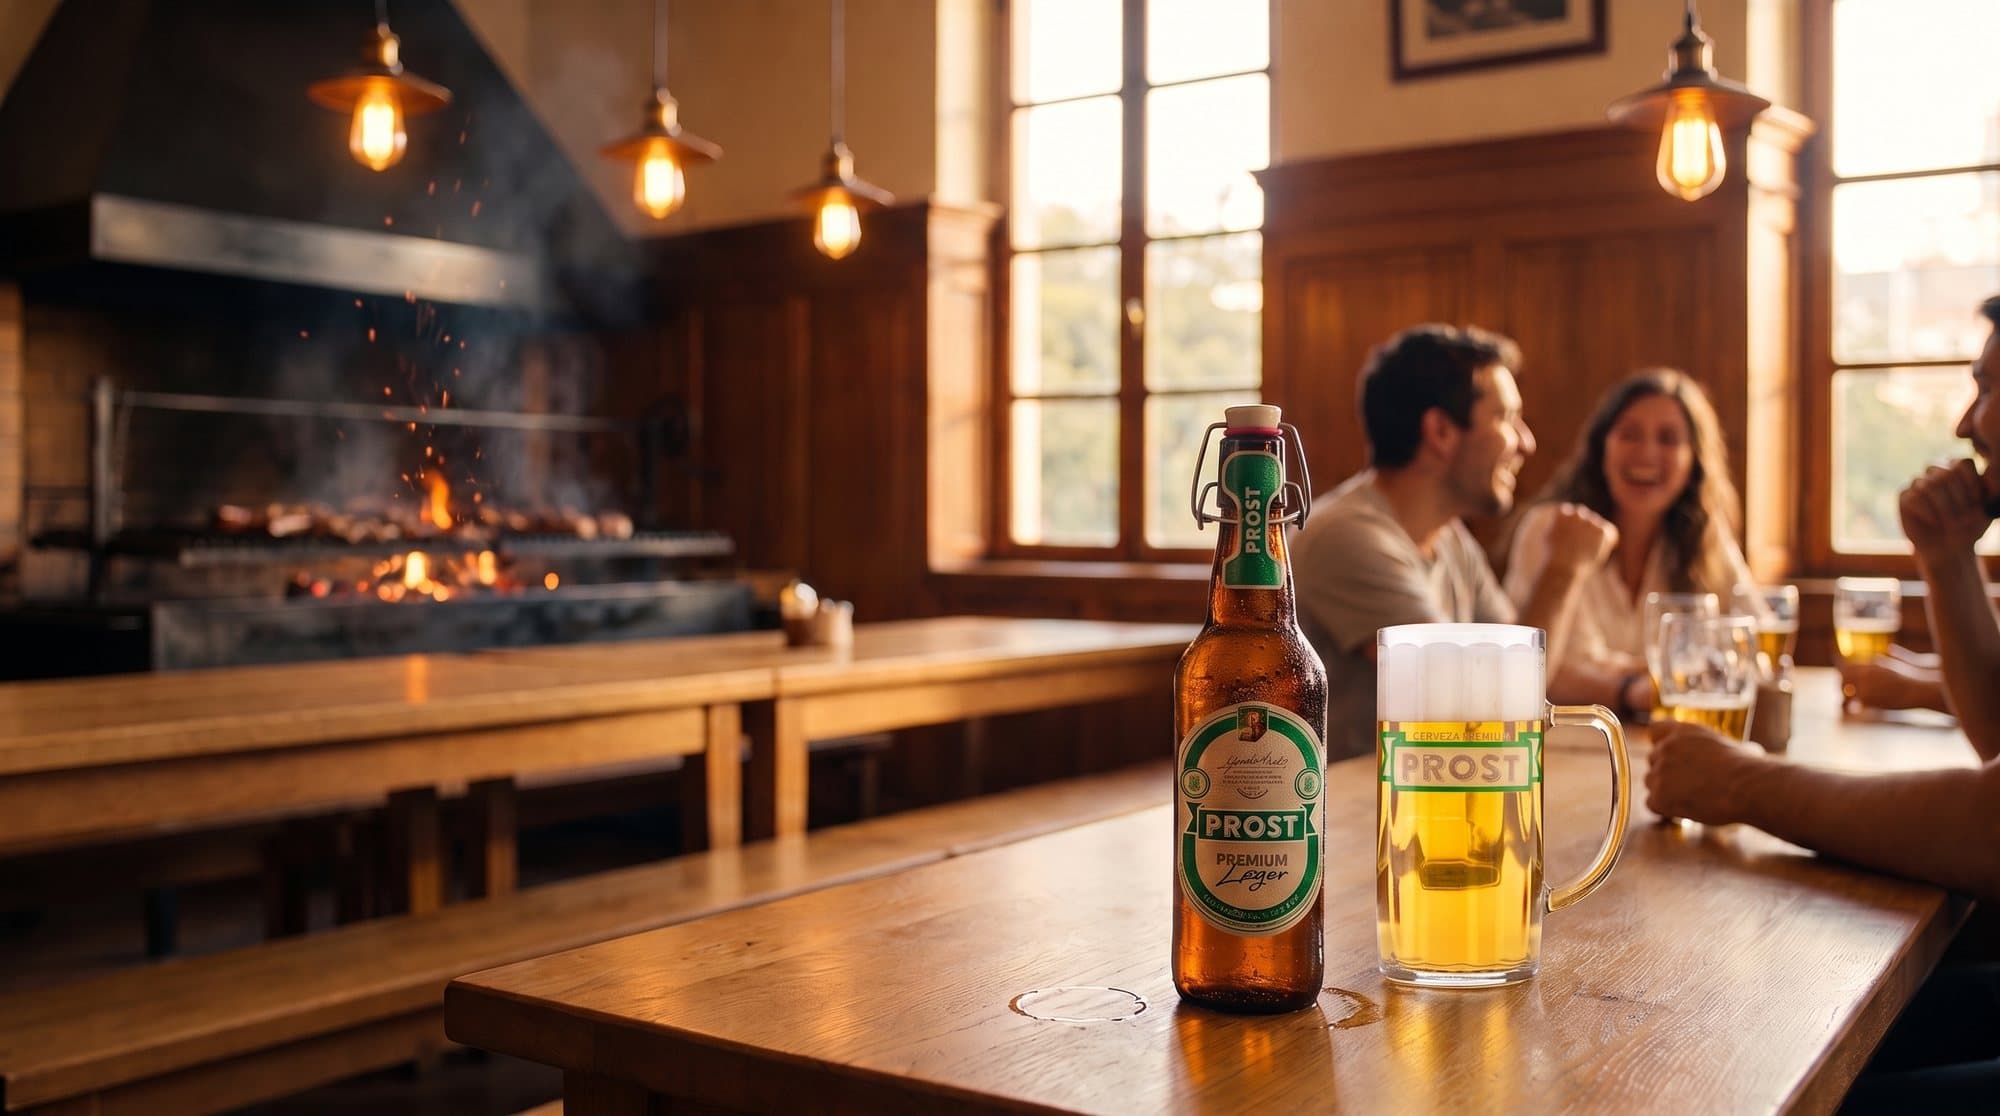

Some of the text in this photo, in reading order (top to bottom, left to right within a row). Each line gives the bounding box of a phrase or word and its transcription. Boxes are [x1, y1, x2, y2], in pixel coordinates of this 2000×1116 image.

[1245, 486, 1261, 554] PROST
[1412, 731, 1460, 741] CERVEZA
[1402, 753, 1520, 782] PROST
[1205, 814, 1299, 838] PROST
[1216, 853, 1288, 867] PREMIUM
